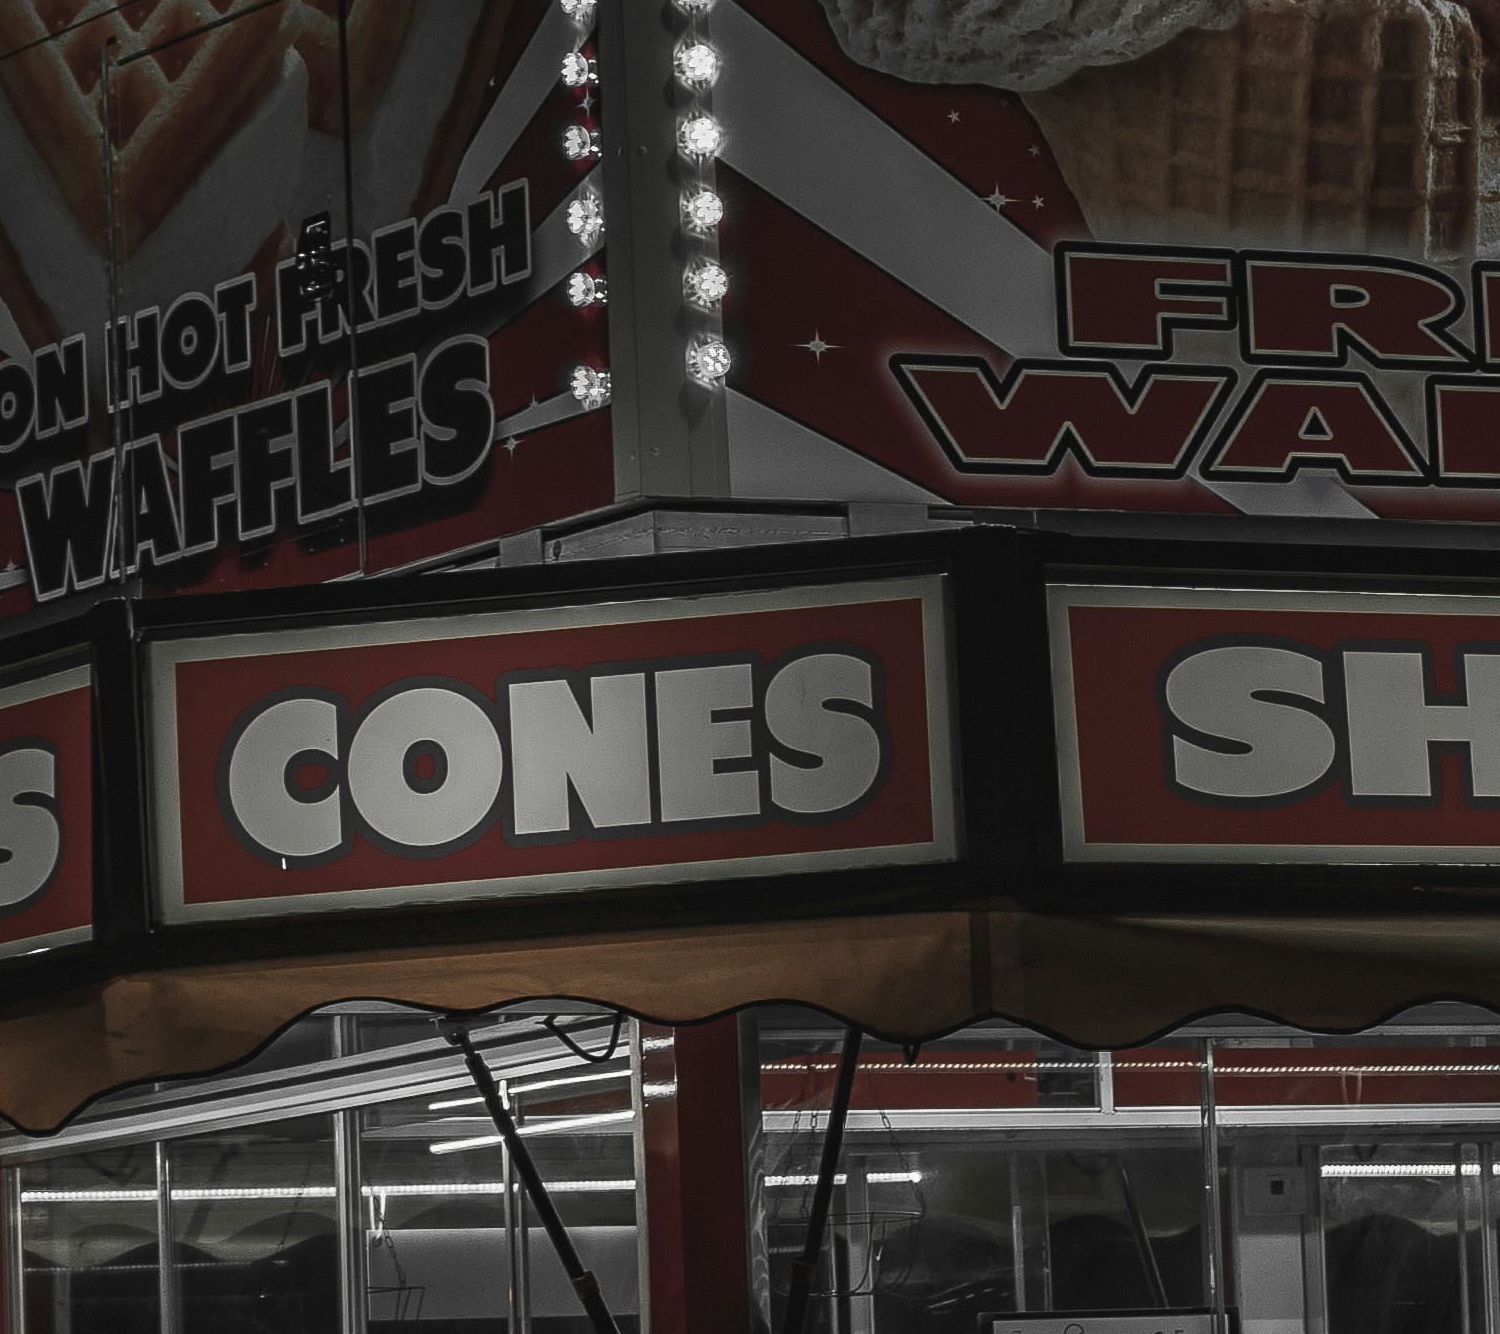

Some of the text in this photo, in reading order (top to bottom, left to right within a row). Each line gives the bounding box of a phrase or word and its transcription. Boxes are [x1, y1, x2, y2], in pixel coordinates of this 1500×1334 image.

[106, 273, 257, 412] HOT
[277, 178, 532, 358] FRESH
[15, 334, 494, 602] WAFFLES
[229, 652, 883, 857] CONES
